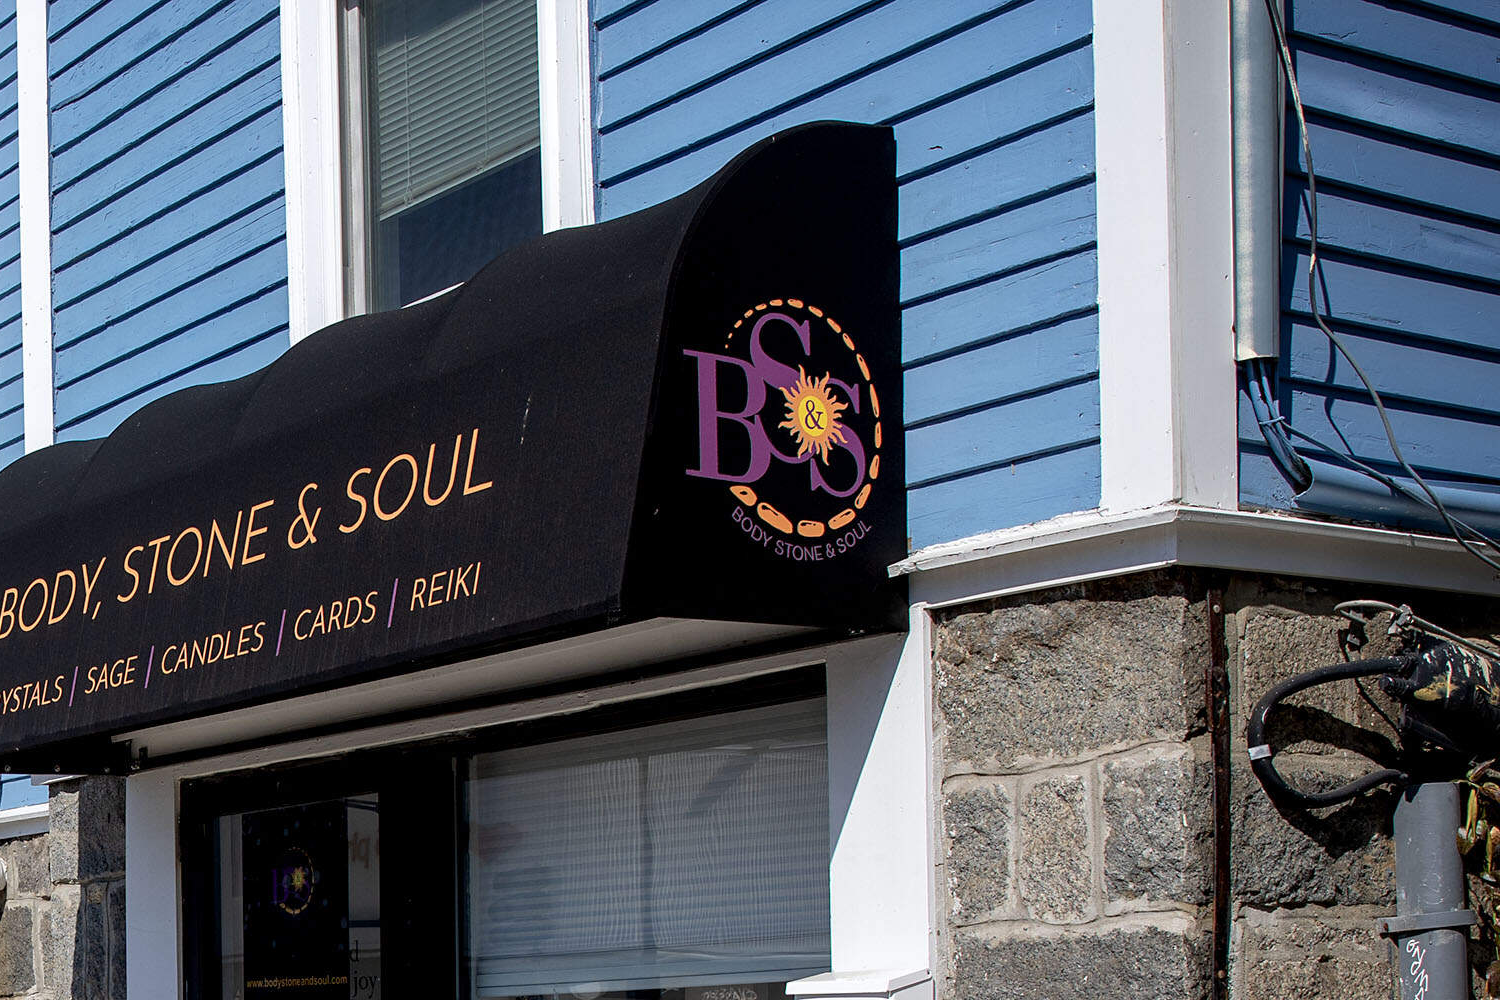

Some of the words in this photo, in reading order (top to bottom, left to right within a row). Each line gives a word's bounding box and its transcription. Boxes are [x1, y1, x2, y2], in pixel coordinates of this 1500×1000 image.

[117, 499, 275, 603] STONE
[287, 482, 321, 550] &
[339, 428, 493, 533] SOUL
[732, 506, 773, 547] BODY
[775, 540, 824, 561] STONE
[826, 543, 836, 558] &
[836, 520, 873, 553] SOUL
[84, 655, 138, 694] SAGE
[161, 621, 266, 675] CANDLES
[294, 591, 378, 640] CARDS
[410, 561, 482, 611] REIKI
[247, 974, 348, 989] www.bodystoneandsoul.com
